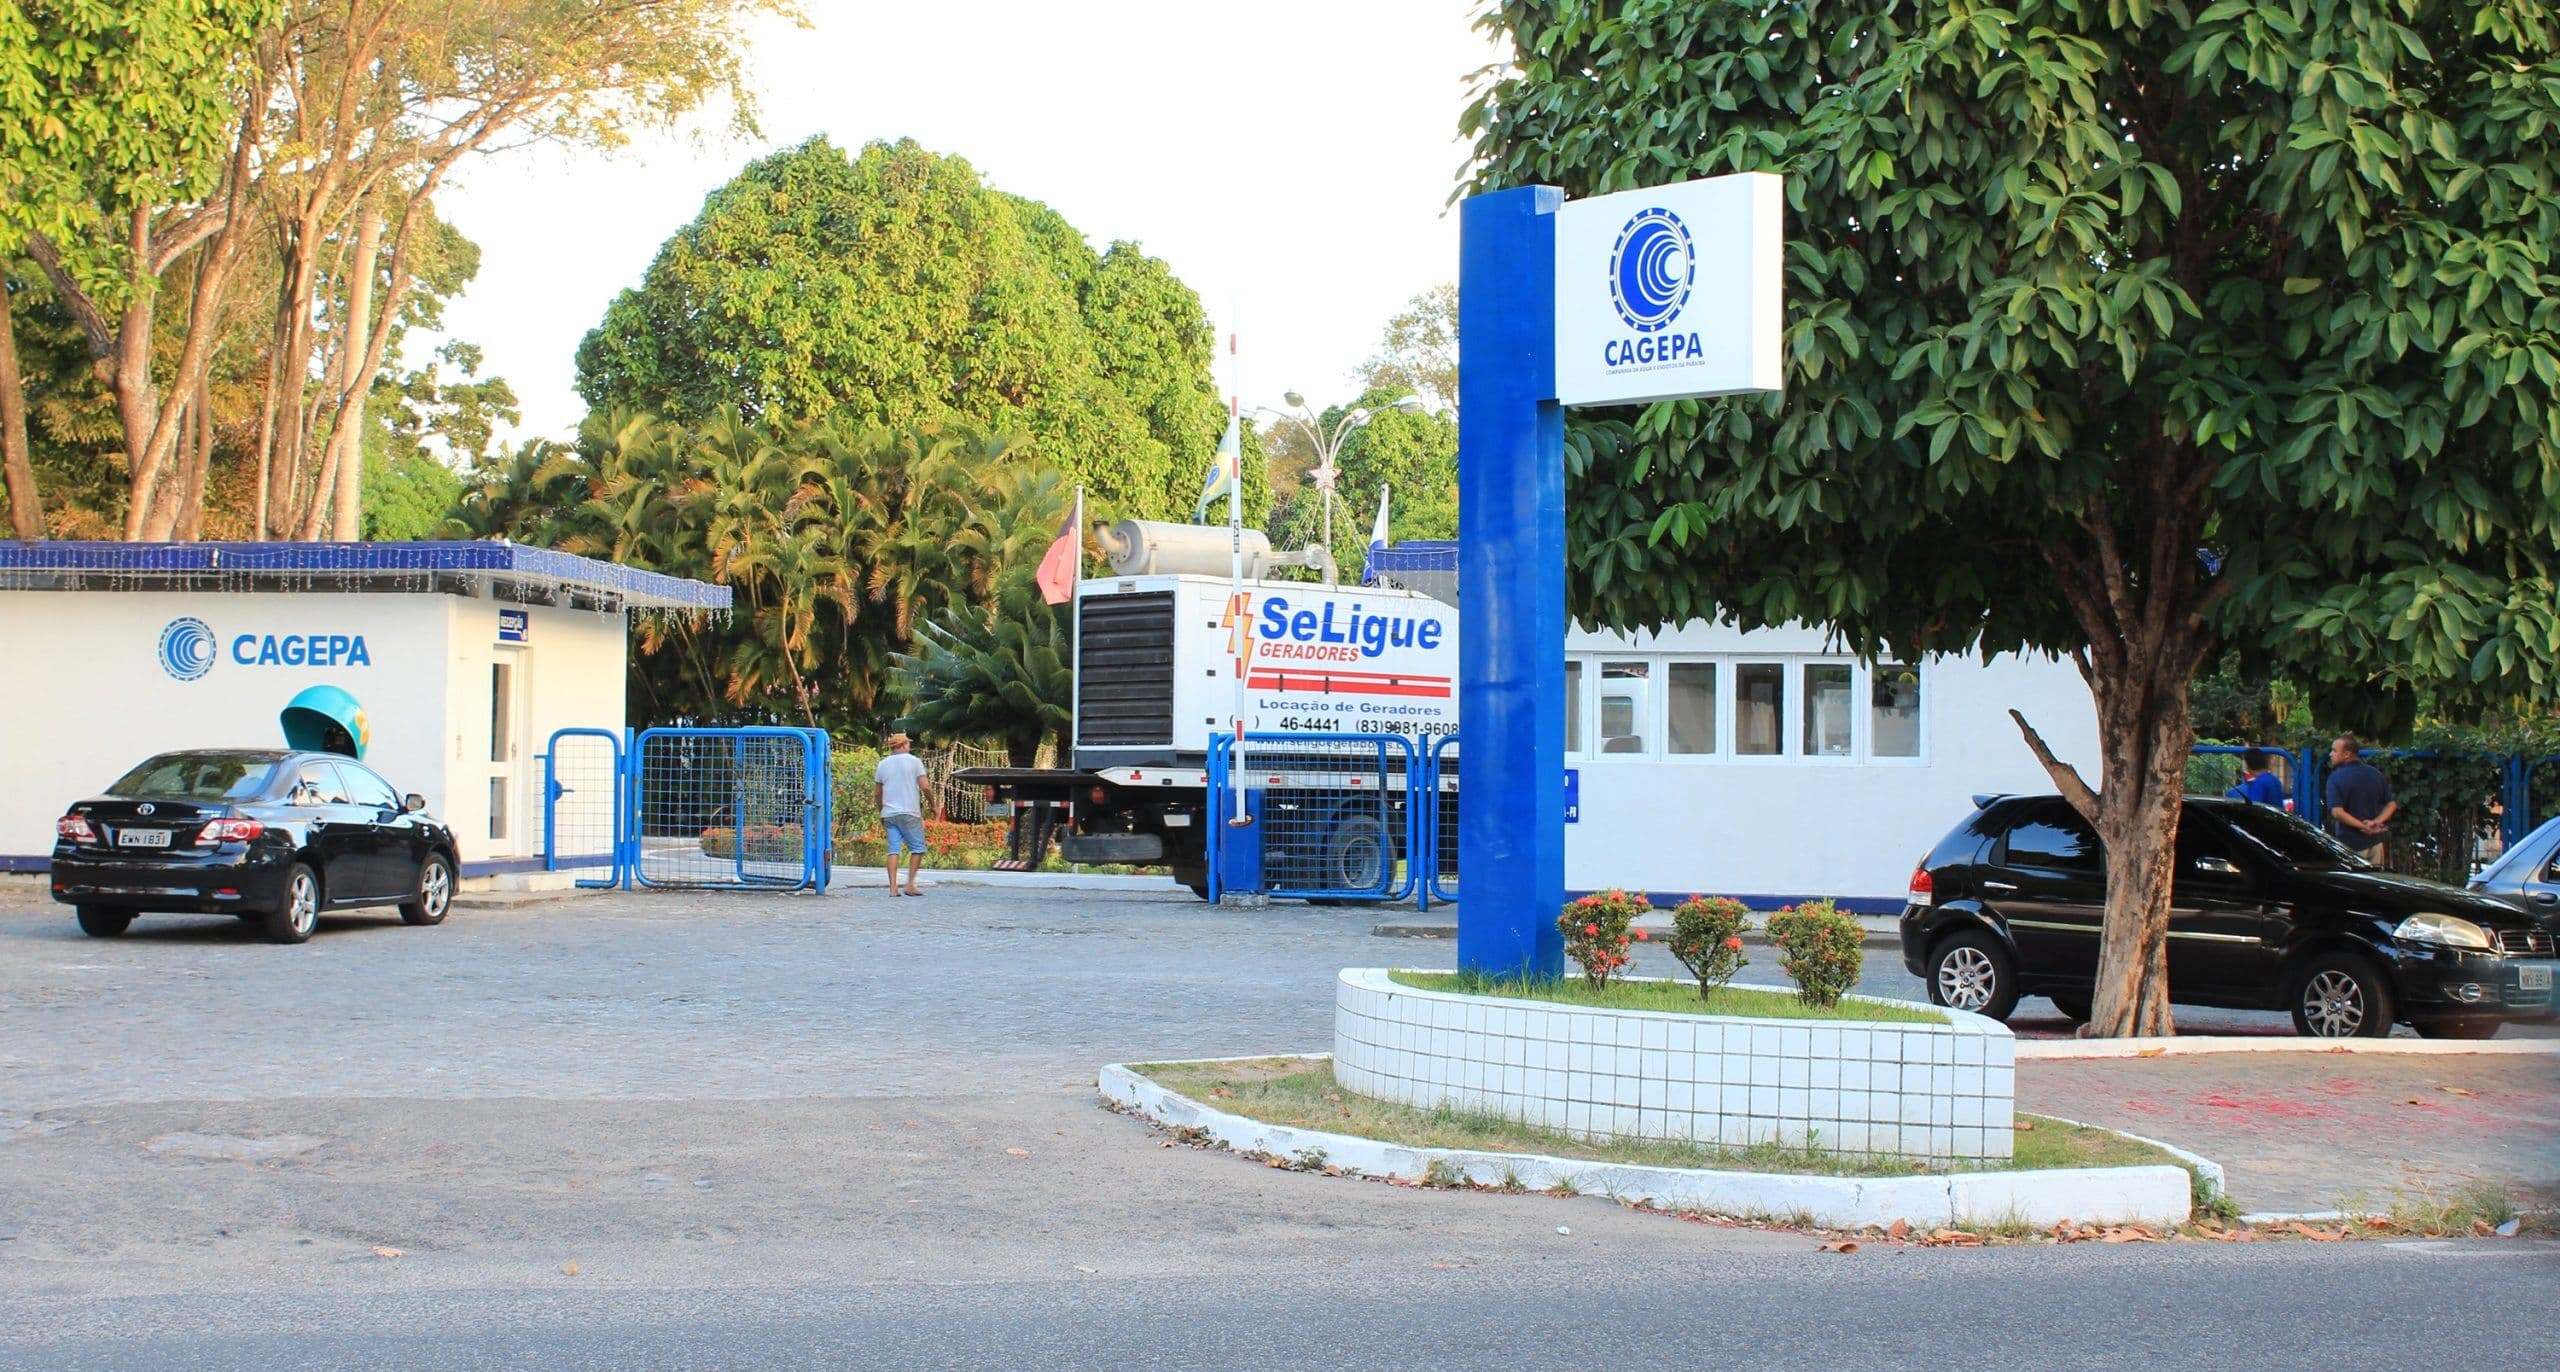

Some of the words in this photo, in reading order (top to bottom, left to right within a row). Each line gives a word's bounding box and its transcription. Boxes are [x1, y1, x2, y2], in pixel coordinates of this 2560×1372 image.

[1604, 332, 1703, 367] CAGEPA
[1259, 597, 1442, 657] SeLigue
[232, 634, 371, 666] CAGEPA
[1260, 642, 1360, 662] GERADORES
[1260, 698, 1330, 712] Locação
[1335, 701, 1354, 712] de
[1360, 702, 1442, 716] Geradores
